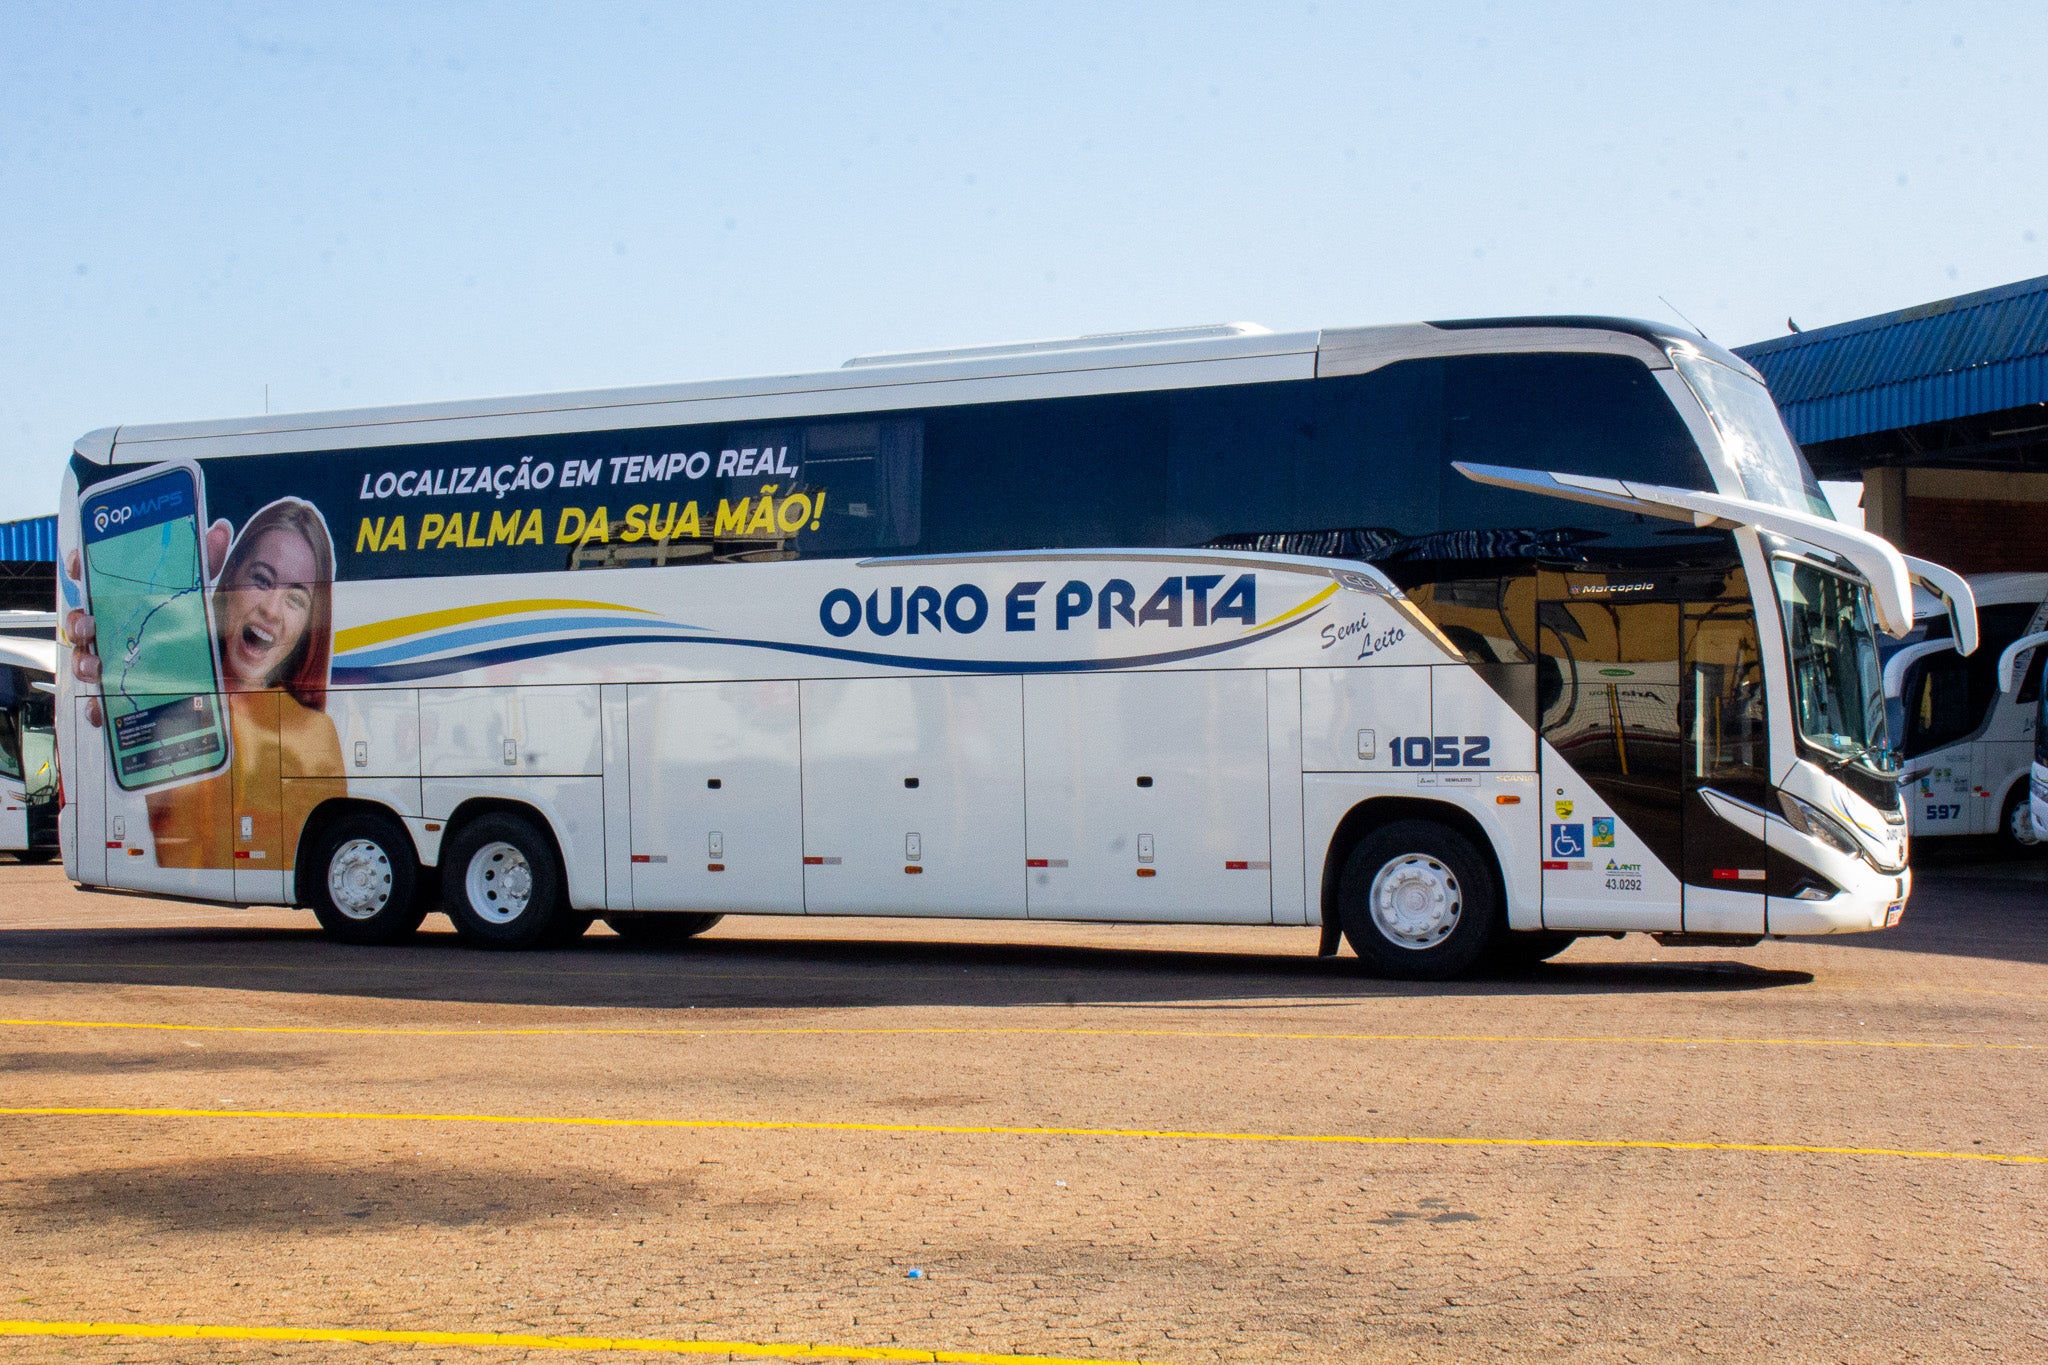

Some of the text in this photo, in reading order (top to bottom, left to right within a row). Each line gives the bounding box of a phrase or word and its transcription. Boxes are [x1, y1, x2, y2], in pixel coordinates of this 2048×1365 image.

[359, 446, 798, 499] LOCALIZAÇÃO EM TEMPO REAL,
[355, 484, 826, 553] NA PALMA DA SUA MÃO!
[1581, 582, 1655, 594] Marcopolo
[819, 573, 1257, 638] OURO E PRATA
[1320, 612, 1369, 650] Semi
[1357, 627, 1406, 661] Leito
[1388, 735, 1491, 767] 1052
[1495, 774, 1535, 783] SCANIA
[1926, 804, 1961, 820] 597
[1605, 878, 1642, 891] 43.0292
